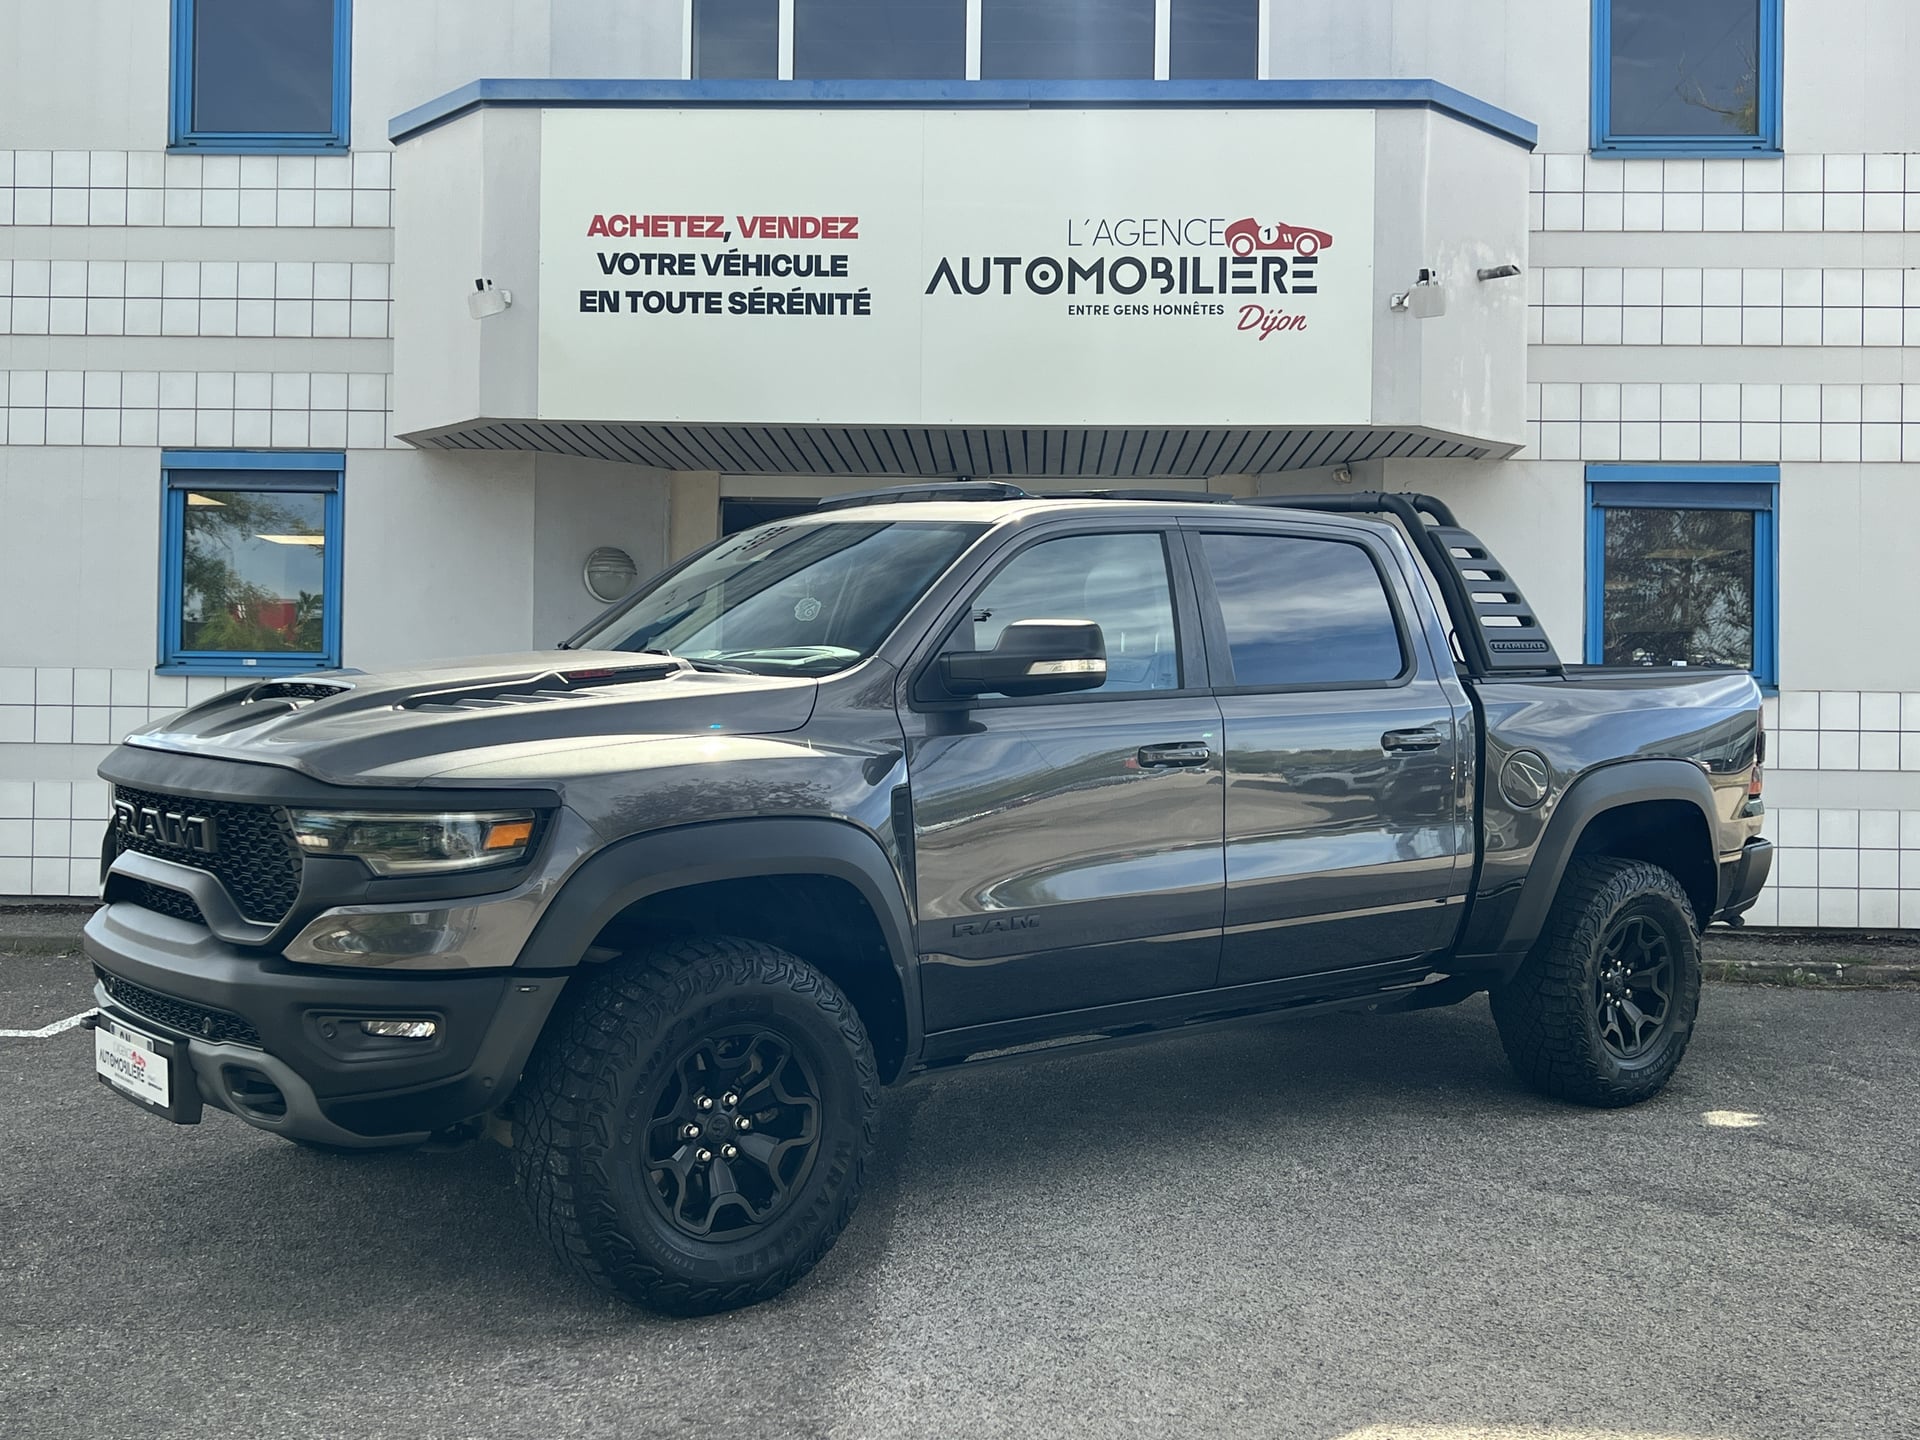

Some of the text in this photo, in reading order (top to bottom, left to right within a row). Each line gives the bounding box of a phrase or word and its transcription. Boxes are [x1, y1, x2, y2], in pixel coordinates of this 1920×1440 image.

[587, 214, 859, 243] ACHETEZ, VENDEZ
[597, 248, 849, 277] VOTRE VÉHICULE
[579, 286, 872, 316] EN TOUTE SÉRÉNITÉ
[1067, 300, 1225, 316] ENTRE GENS HONNÊTES
[1236, 303, 1309, 341] Dijon
[115, 799, 216, 853] RAM
[952, 913, 1041, 938] RAM
